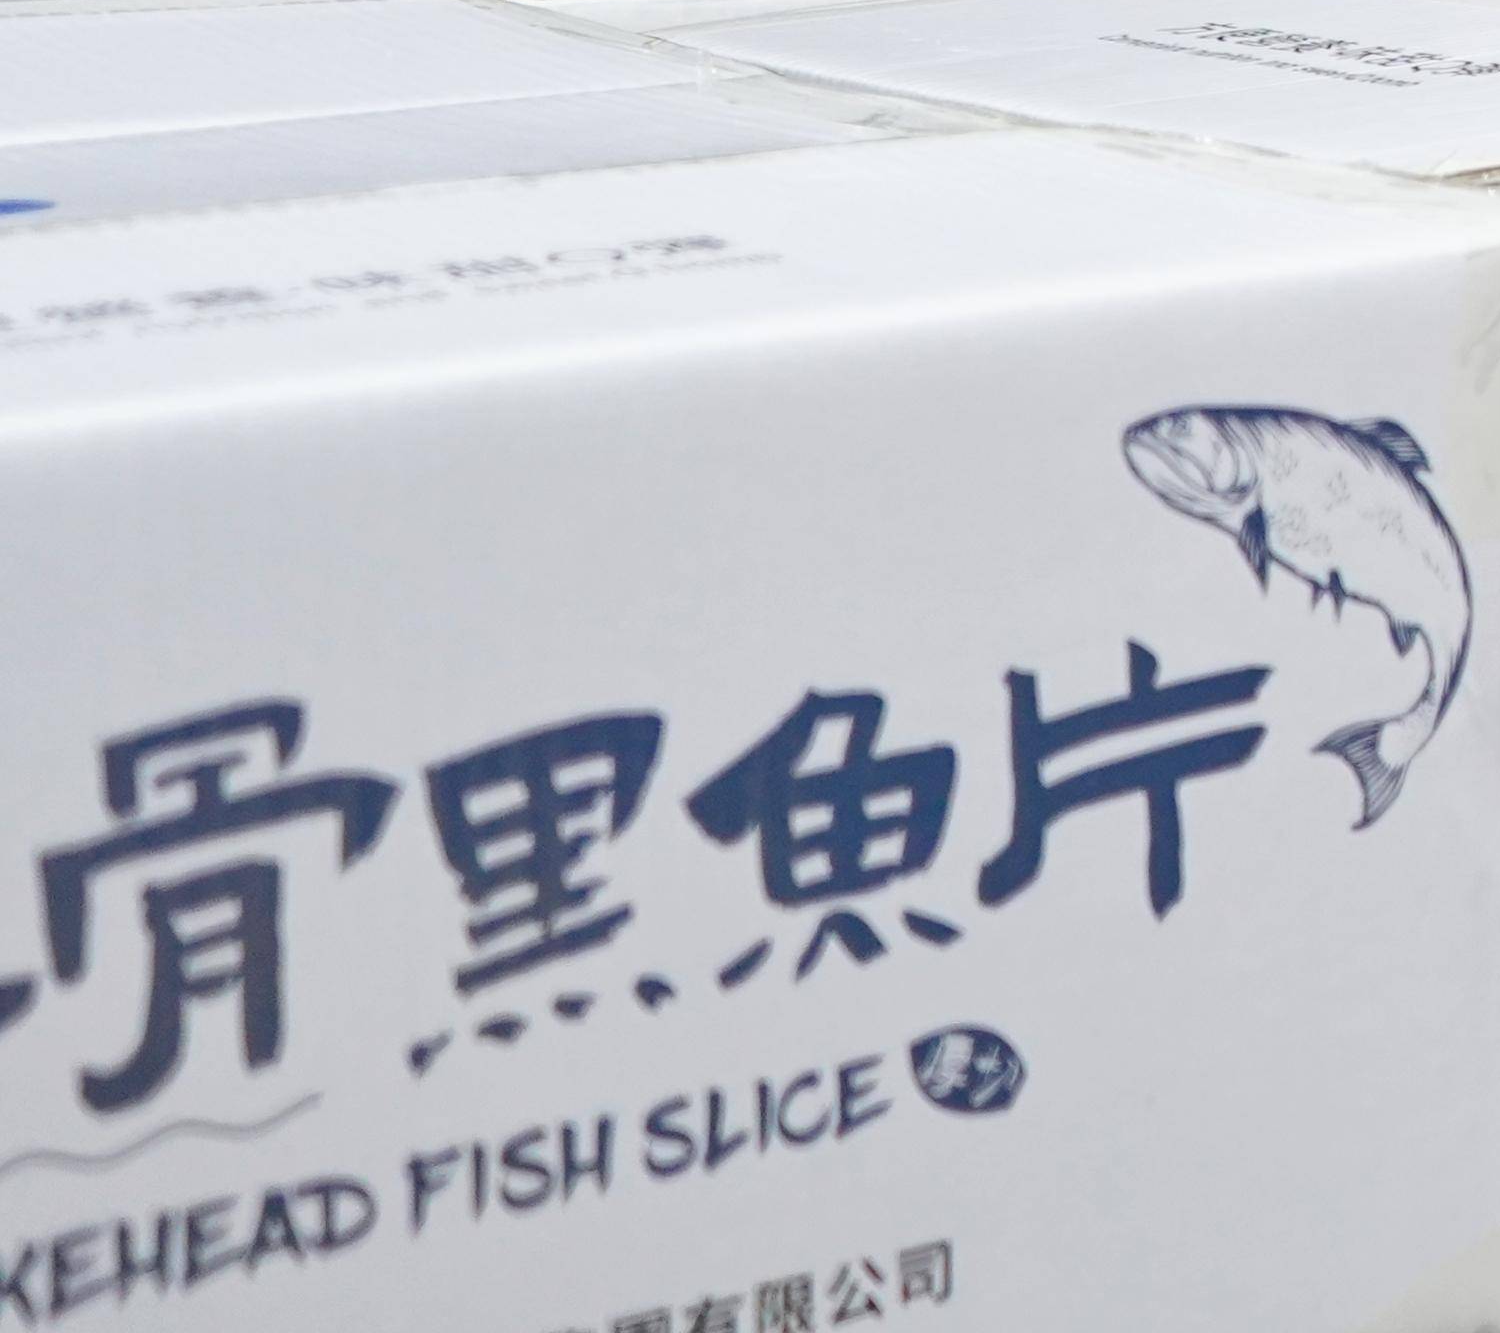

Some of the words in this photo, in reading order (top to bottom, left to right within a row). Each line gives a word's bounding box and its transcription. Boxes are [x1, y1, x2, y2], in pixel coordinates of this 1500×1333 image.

[0, 637, 1273, 1117] 骨黑魚片
[407, 1113, 618, 1235] FISH
[643, 1050, 894, 1182] SLICE
